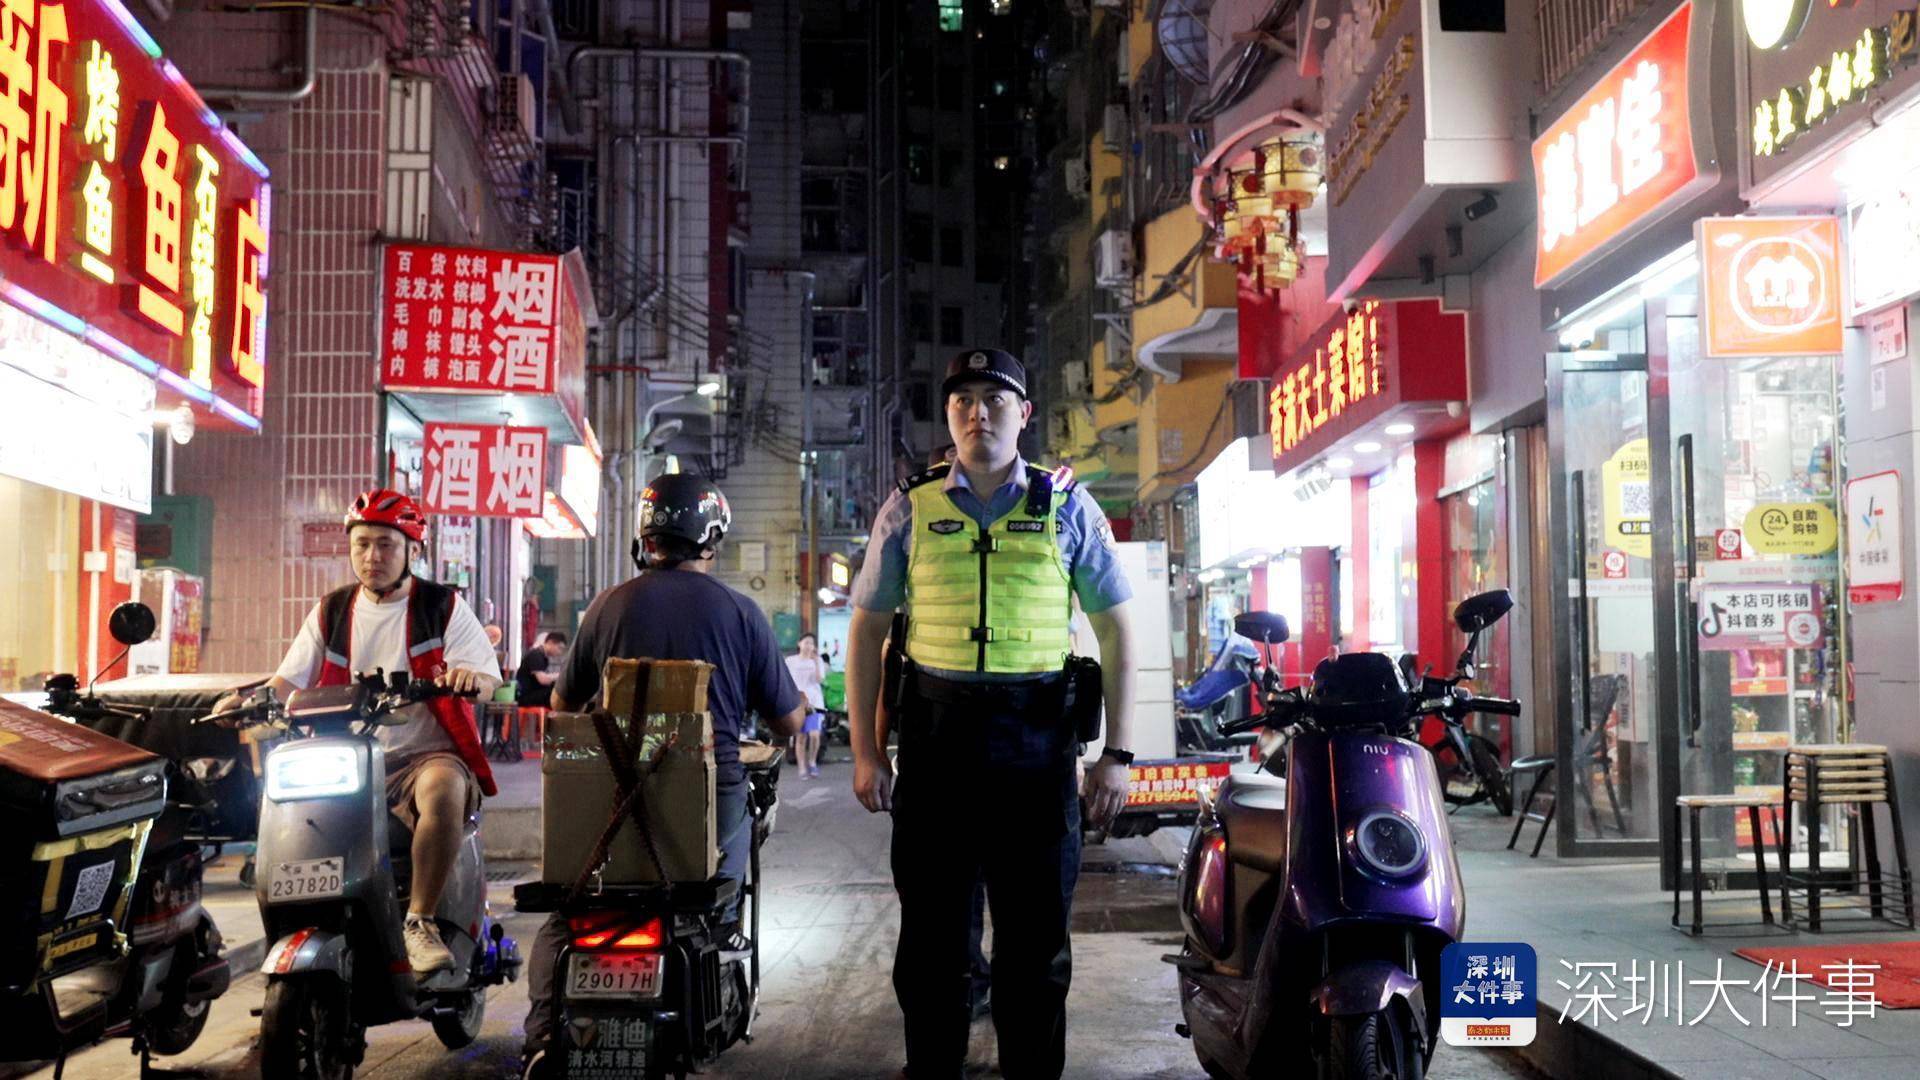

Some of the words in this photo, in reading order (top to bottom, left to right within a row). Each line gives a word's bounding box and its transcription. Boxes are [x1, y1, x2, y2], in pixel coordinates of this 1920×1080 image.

[82, 39, 120, 284] 烤鱼
[455, 254, 488, 279] 饮料
[394, 277, 444, 301] 洗发水
[453, 281, 487, 304] 槟榔
[393, 303, 443, 327] 毛巾
[452, 307, 484, 330] 副食
[488, 259, 555, 390] 烟酒
[450, 332, 482, 357] 馒头
[448, 359, 481, 383] 泡面
[1767, 515, 1782, 524] 24
[1793, 509, 1818, 521] 自助
[1793, 523, 1818, 535] 购物
[1726, 593, 1809, 608] 本店可核销
[1727, 613, 1775, 628] 抖音券
[273, 874, 340, 897] 23782D
[577, 972, 653, 989] 29017H
